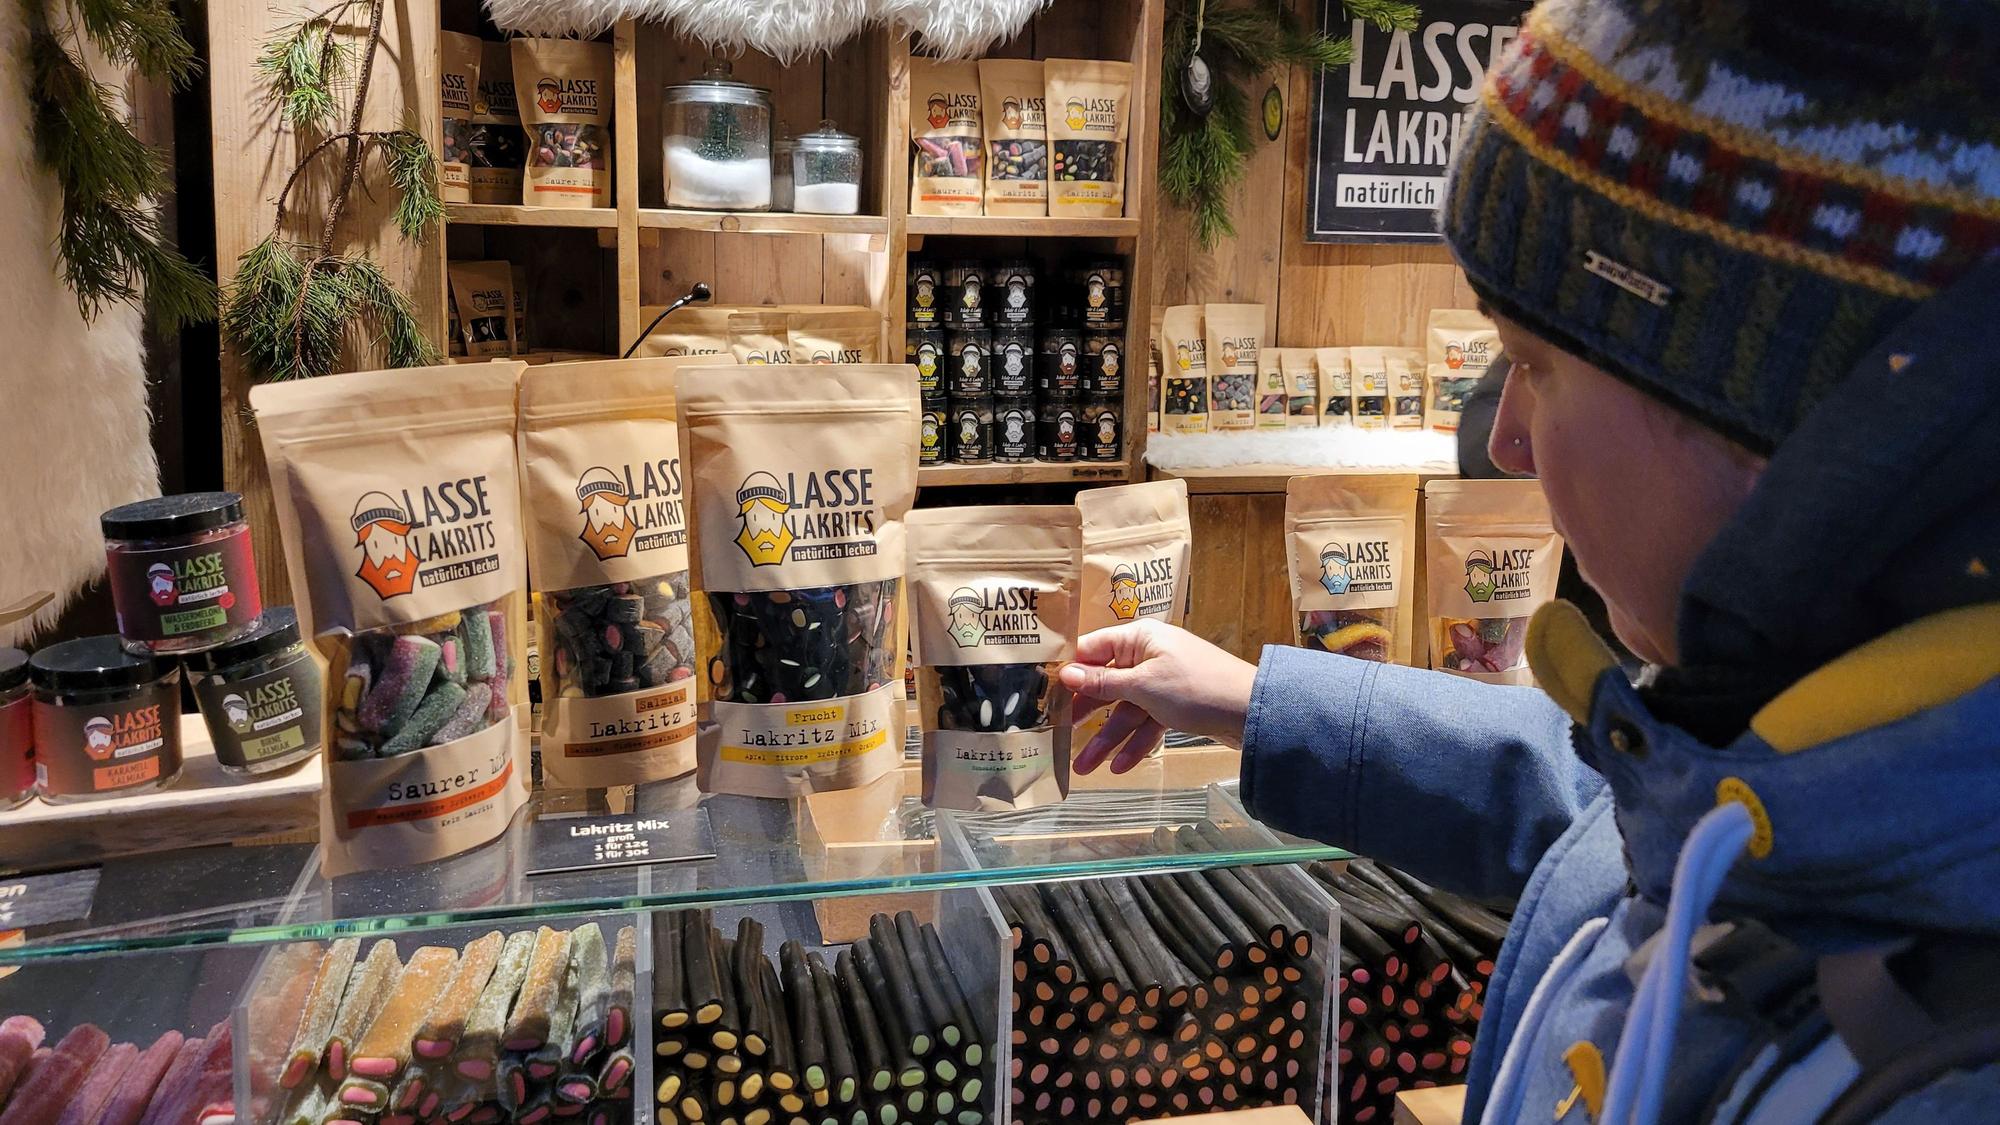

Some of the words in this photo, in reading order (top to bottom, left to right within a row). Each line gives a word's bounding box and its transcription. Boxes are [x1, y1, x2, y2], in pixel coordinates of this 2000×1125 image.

[560, 79, 597, 95] LASSE
[561, 94, 598, 107] LAKRITS
[948, 93, 977, 109] LASSE
[1020, 98, 1045, 112] LASS
[1085, 98, 1116, 113] LASSE
[1086, 113, 1116, 124] LAKRITS
[1345, 182, 1435, 206] natürlich
[1188, 339, 1205, 353] LASS
[1234, 337, 1256, 350] LASSE
[1462, 341, 1488, 354] LASSE
[766, 350, 791, 364] LASS
[831, 350, 862, 364] LASSE
[624, 458, 682, 500] LASS
[787, 468, 874, 509] LASSE
[403, 476, 491, 528] LASSE
[792, 509, 875, 540] LAKRITS
[415, 521, 496, 563] LAKRITS
[637, 532, 678, 551] natürlich
[794, 546, 843, 561] natürlich
[844, 543, 875, 557] lecker
[1347, 541, 1390, 563] LASSE
[1492, 549, 1535, 571] LASSE
[174, 552, 224, 579] LASSE
[422, 565, 469, 588] natürlich
[470, 558, 499, 577] lecker
[1134, 557, 1173, 584] LASSE
[1349, 564, 1391, 582] LAKRITS
[178, 572, 226, 593] LAKRITS
[1351, 584, 1376, 593] natürlich
[1376, 583, 1392, 592] lecker
[1494, 571, 1531, 589] LAKRITS
[983, 587, 1039, 611] LASSE
[1138, 583, 1174, 603] LAKRITS
[985, 613, 1039, 632] LAKRITS
[985, 635, 1018, 646] natürlich
[1019, 634, 1040, 645] lecker
[245, 677, 295, 708] LASSE
[250, 695, 299, 721] LAKRITS
[794, 710, 837, 723] Frucht
[114, 704, 160, 733] LASSE
[590, 711, 682, 738] Lakritz
[115, 723, 162, 748] LAKRITS
[742, 728, 835, 746] Lakritz
[848, 719, 877, 738] Mix
[956, 747, 1013, 762] Lakritz
[389, 768, 479, 801] Saurer
[571, 822, 633, 837] Lakritz
[637, 820, 670, 831] Mix
[595, 852, 603, 860] 3
[605, 850, 623, 858] für
[625, 848, 649, 857] 30€
[605, 842, 622, 850] für
[625, 840, 648, 849] 12€
